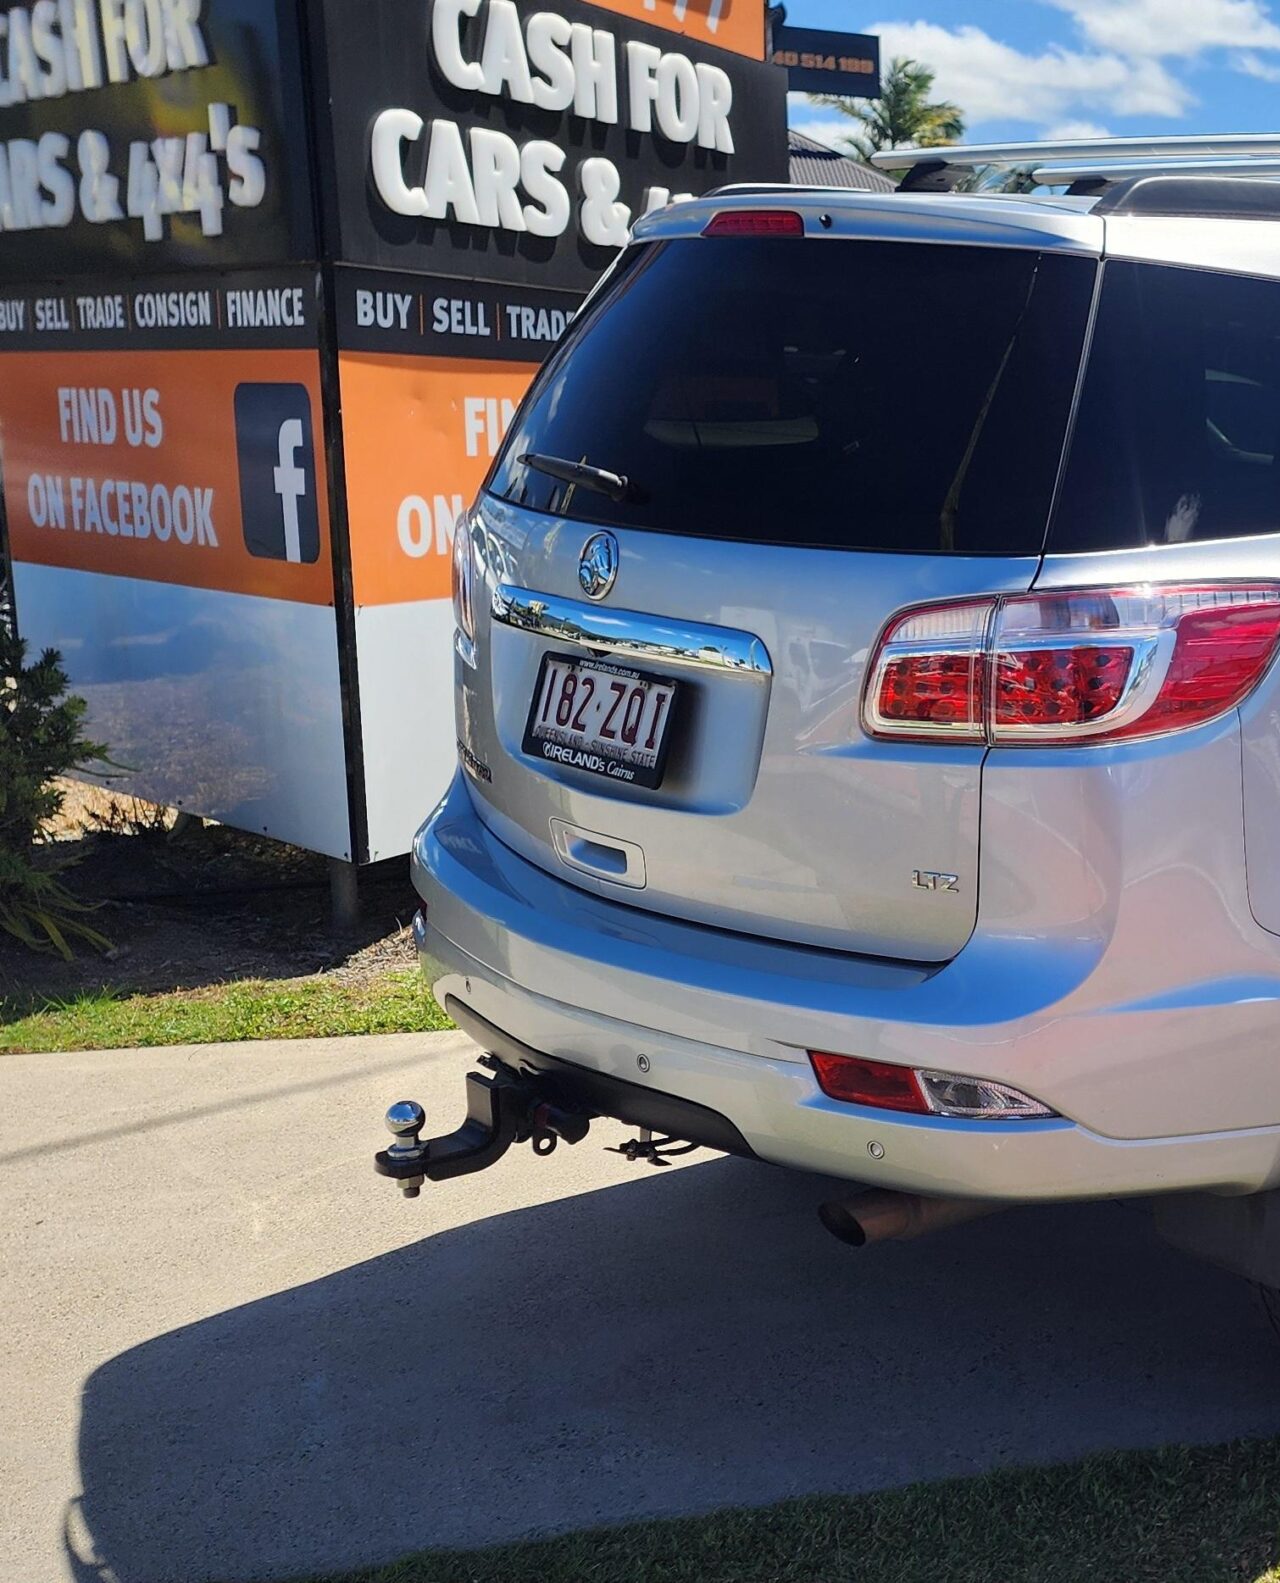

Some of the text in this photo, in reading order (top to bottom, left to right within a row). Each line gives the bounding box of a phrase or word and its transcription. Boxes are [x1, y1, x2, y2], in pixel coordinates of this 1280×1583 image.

[101, 0, 210, 83] FOR
[432, 0, 735, 155] CASH FOR
[77, 129, 124, 223] &
[371, 108, 633, 248] CARS &
[0, 287, 305, 331] BUY SELL TRADE CONSIGN FINANCE
[356, 289, 412, 329] BUY
[432, 297, 491, 336] SELL
[58, 386, 163, 448] FIND US
[27, 473, 219, 548] ON FACEBOOK
[397, 494, 463, 559] ON
[607, 760, 635, 780] Cairns
[911, 869, 960, 893] LTZ
